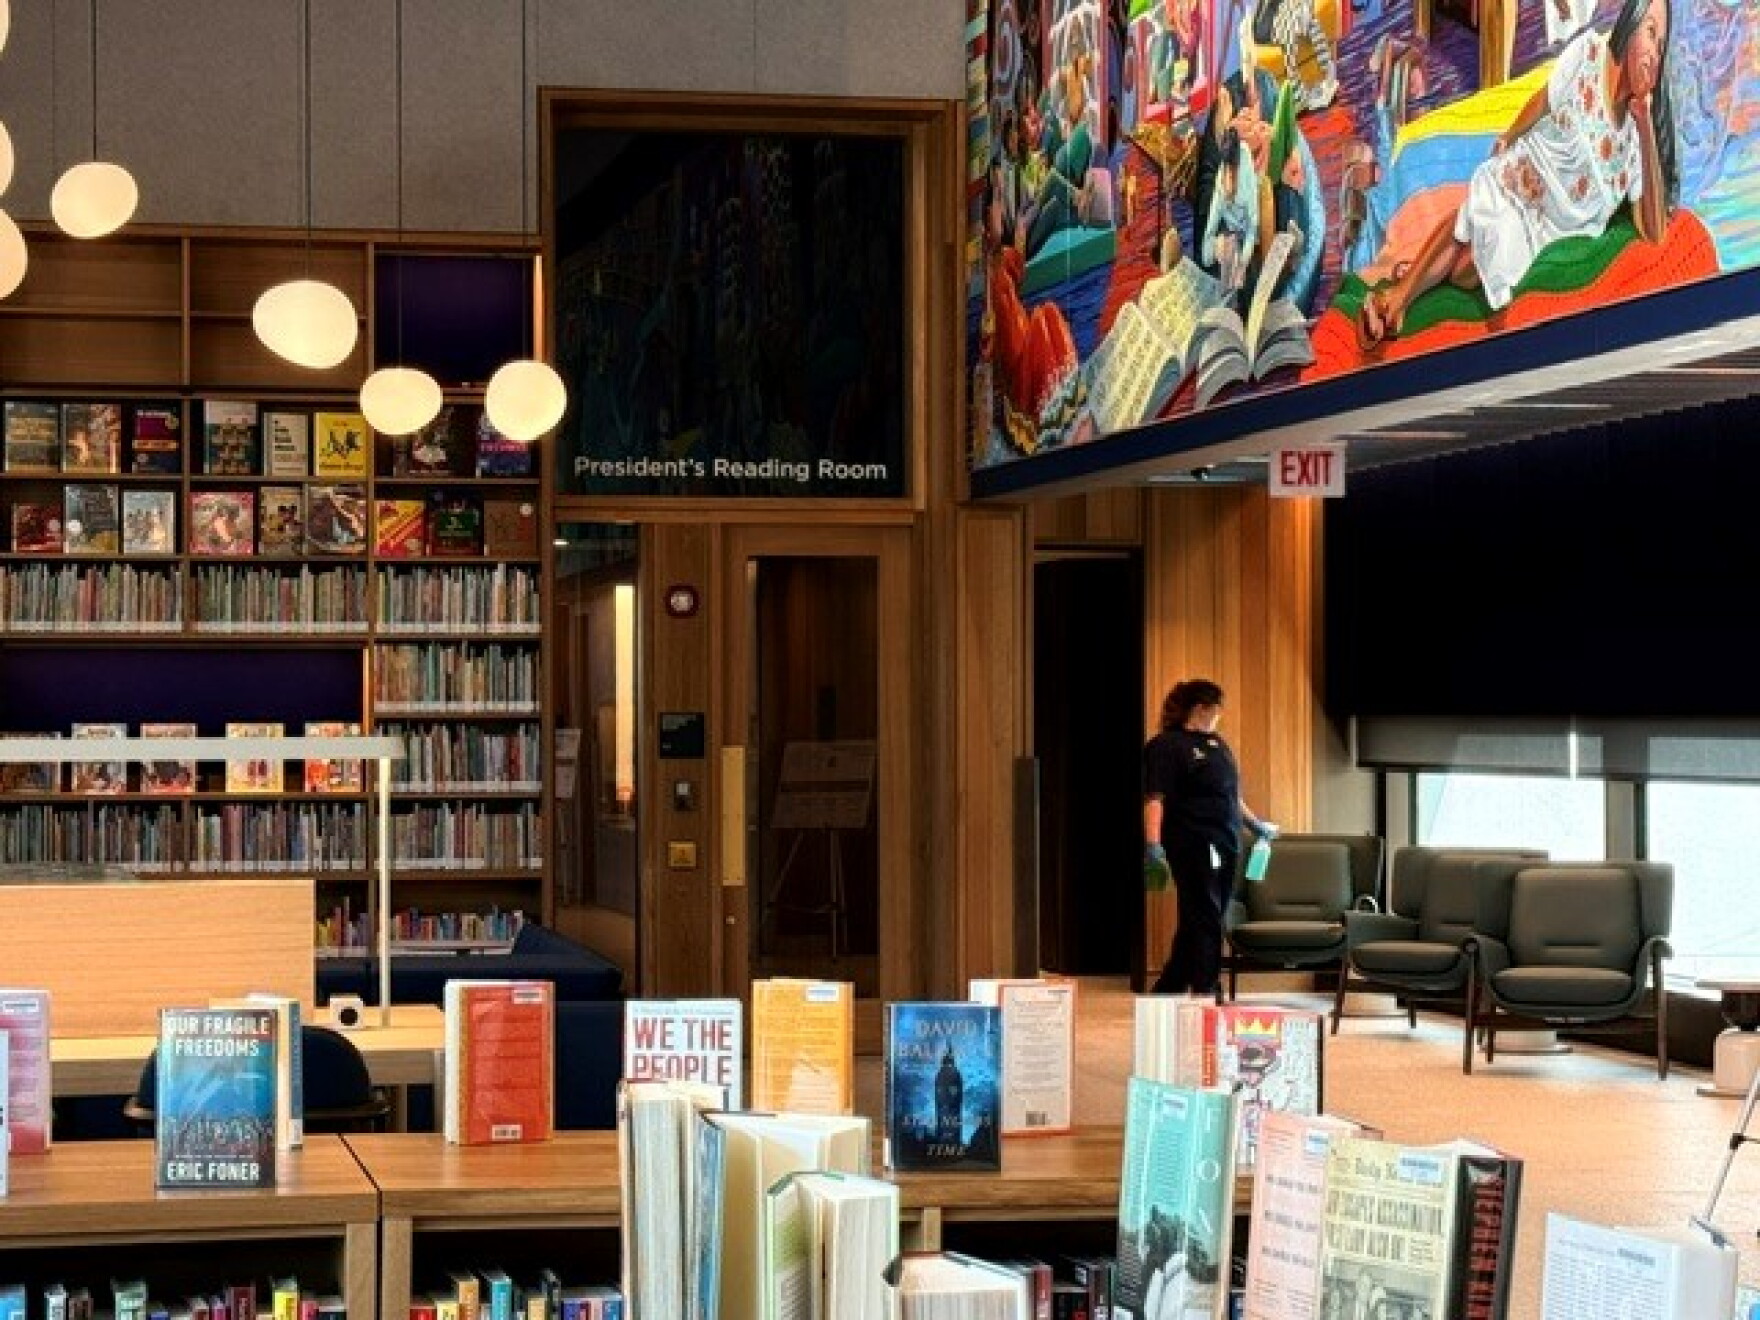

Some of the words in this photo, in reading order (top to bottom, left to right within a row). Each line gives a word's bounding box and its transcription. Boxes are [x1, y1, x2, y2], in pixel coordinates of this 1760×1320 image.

[574, 456, 705, 477] President's
[714, 458, 810, 482] Reading
[818, 459, 888, 480] Room
[1281, 450, 1334, 486] EXIT
[166, 1016, 199, 1035] OUR
[202, 1016, 270, 1035] FRAGILE
[633, 1017, 674, 1050] WE
[682, 1018, 732, 1051] THE
[175, 1038, 260, 1057] FREEDOMS
[633, 1054, 732, 1086] PEOPLE
[167, 1162, 204, 1181] ERIC
[208, 1162, 260, 1181] FONER
